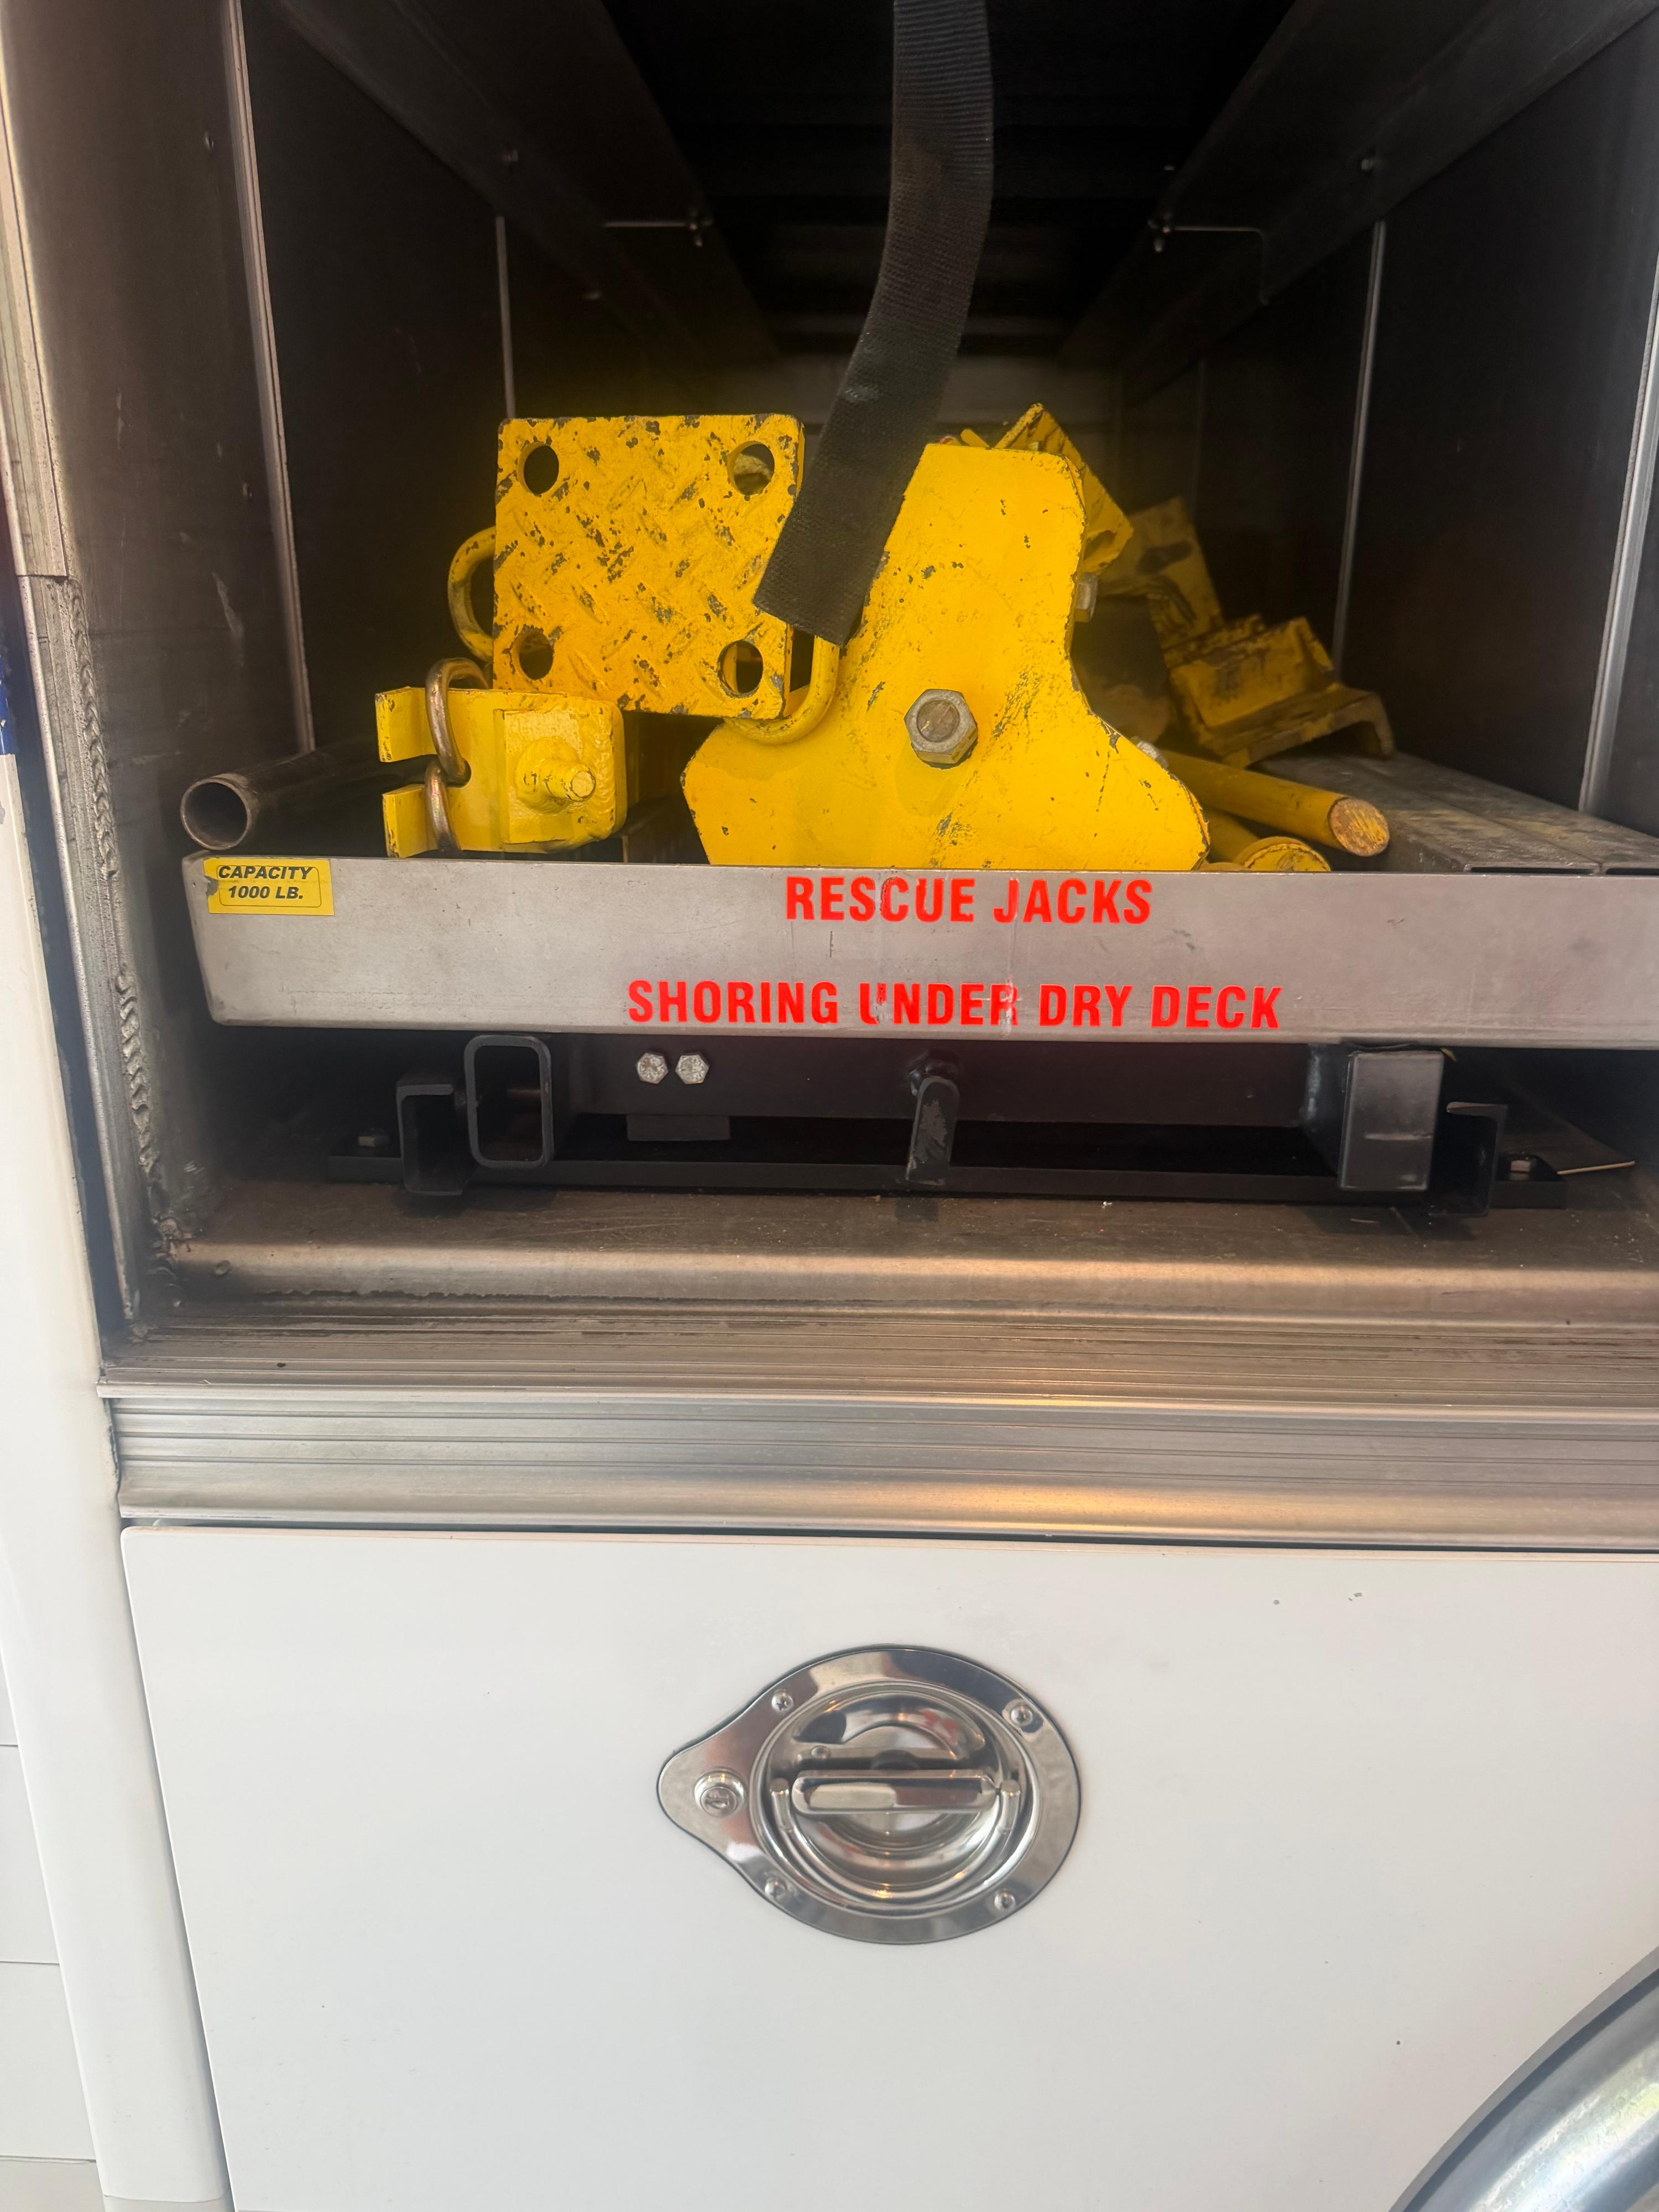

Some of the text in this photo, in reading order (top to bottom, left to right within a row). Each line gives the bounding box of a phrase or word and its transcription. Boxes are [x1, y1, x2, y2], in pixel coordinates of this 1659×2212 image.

[219, 866, 312, 879] CAPACITY
[228, 886, 303, 899] 1000 LB.
[786, 876, 1152, 925] RESCUE JACKS
[628, 979, 1283, 1031] SHORING UNDER DRY DECK
